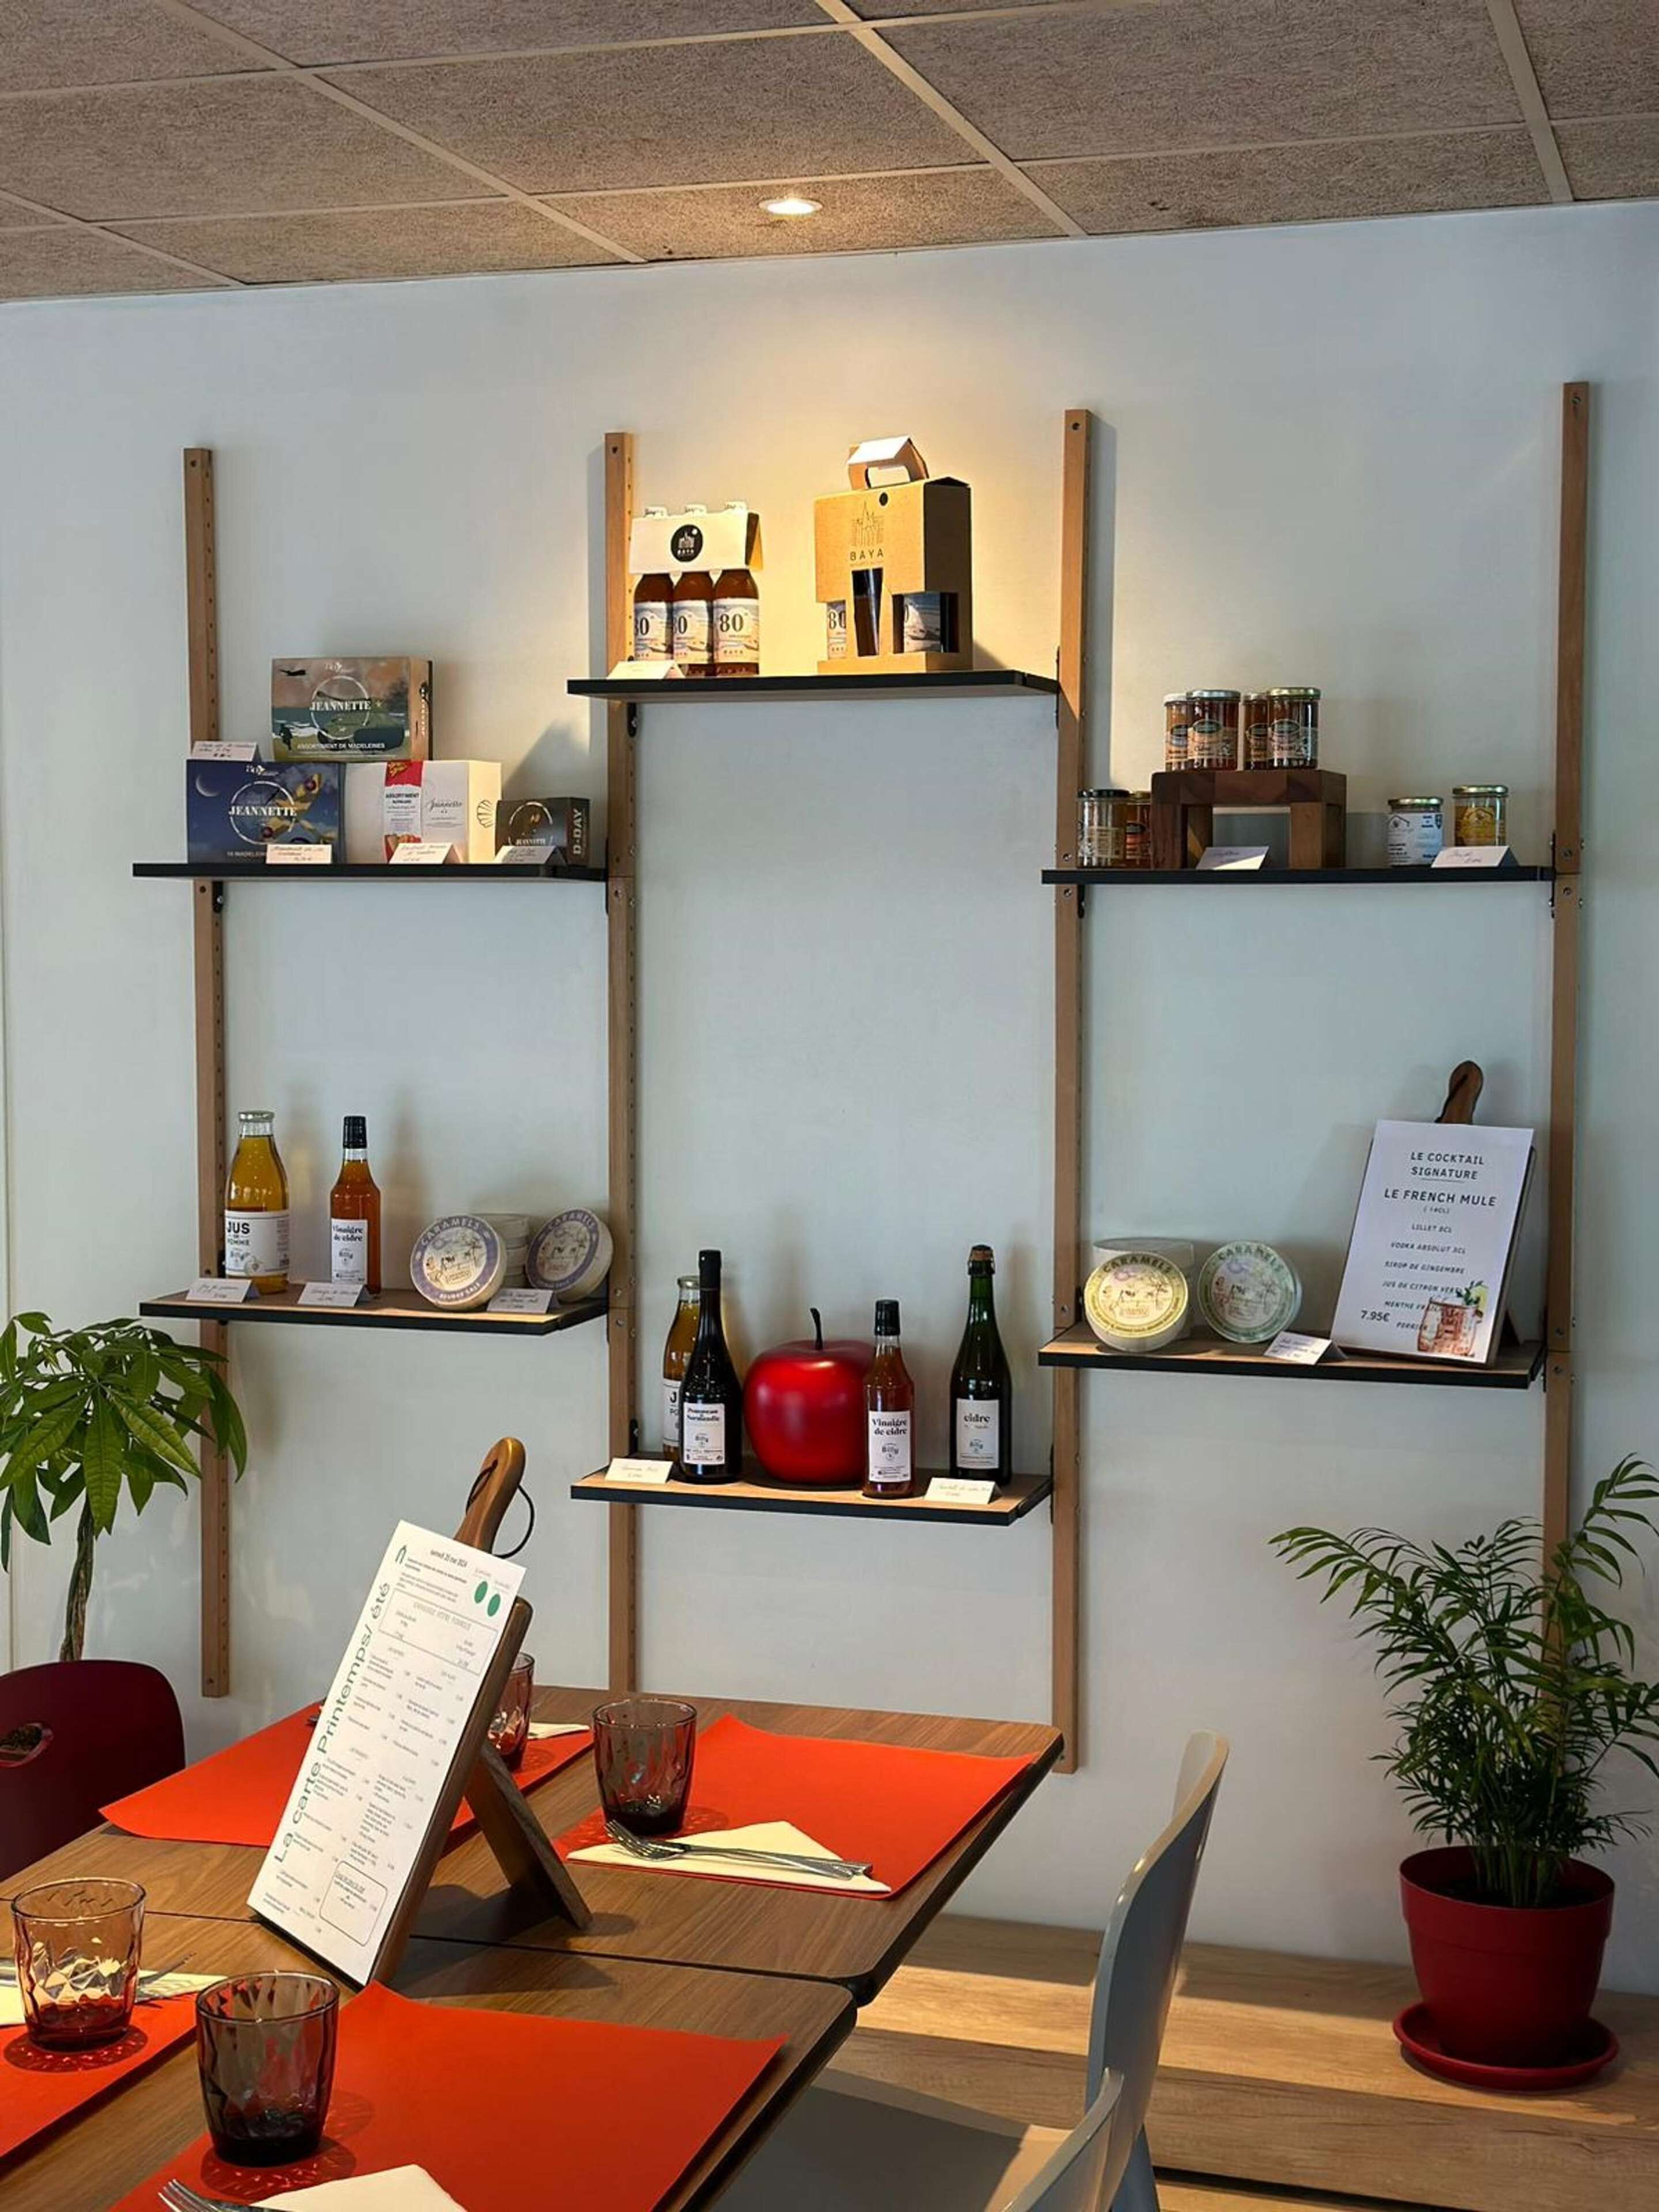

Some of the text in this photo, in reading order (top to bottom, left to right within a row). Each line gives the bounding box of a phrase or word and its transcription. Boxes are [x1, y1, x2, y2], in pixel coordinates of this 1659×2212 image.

[850, 548, 884, 561] BAYA
[309, 700, 372, 711] JEANNETTE
[228, 806, 298, 817] JEANNETTE
[573, 808, 582, 854] D-DAY
[1411, 1152, 1484, 1165] LE COCKTAIL
[1411, 1166, 1479, 1180] SIGNATURE
[1384, 1188, 1497, 1207] LE FRENCH MULE
[227, 1221, 251, 1235] JUS
[421, 1217, 480, 1246] CARAMELS
[1103, 1255, 1171, 1274] CARAMELS
[1218, 1245, 1283, 1272] CARAMELS
[1360, 1310, 1391, 1323] 7.95€
[872, 1418, 908, 1427] Vinaigre
[964, 1412, 991, 1423] cidre
[874, 1427, 908, 1435] de cidre
[274, 1581, 391, 1865] La carte Printemps/ été
